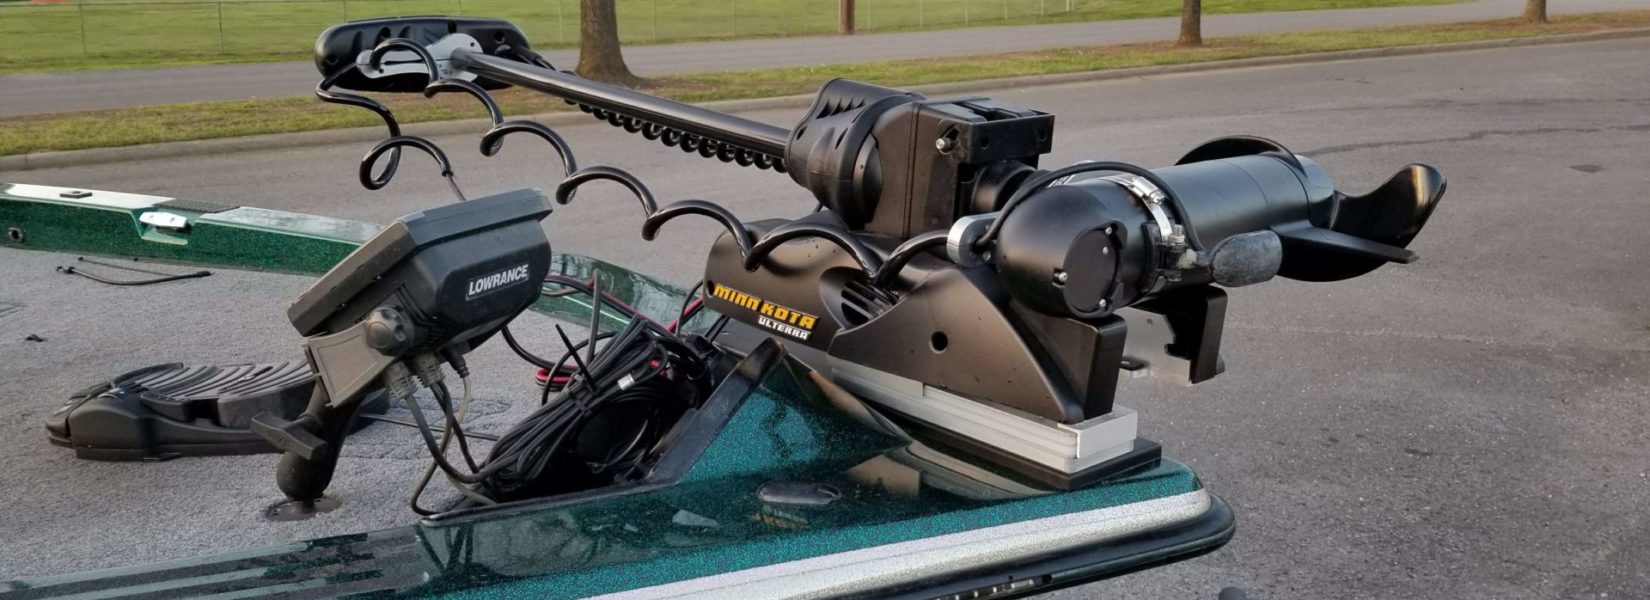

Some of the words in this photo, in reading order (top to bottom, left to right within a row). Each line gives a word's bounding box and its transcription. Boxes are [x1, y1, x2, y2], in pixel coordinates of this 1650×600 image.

[468, 264, 529, 296] LOWRANCE
[713, 283, 761, 311] MINN
[761, 303, 817, 330] KOTA
[758, 316, 809, 341] ULTERRA
